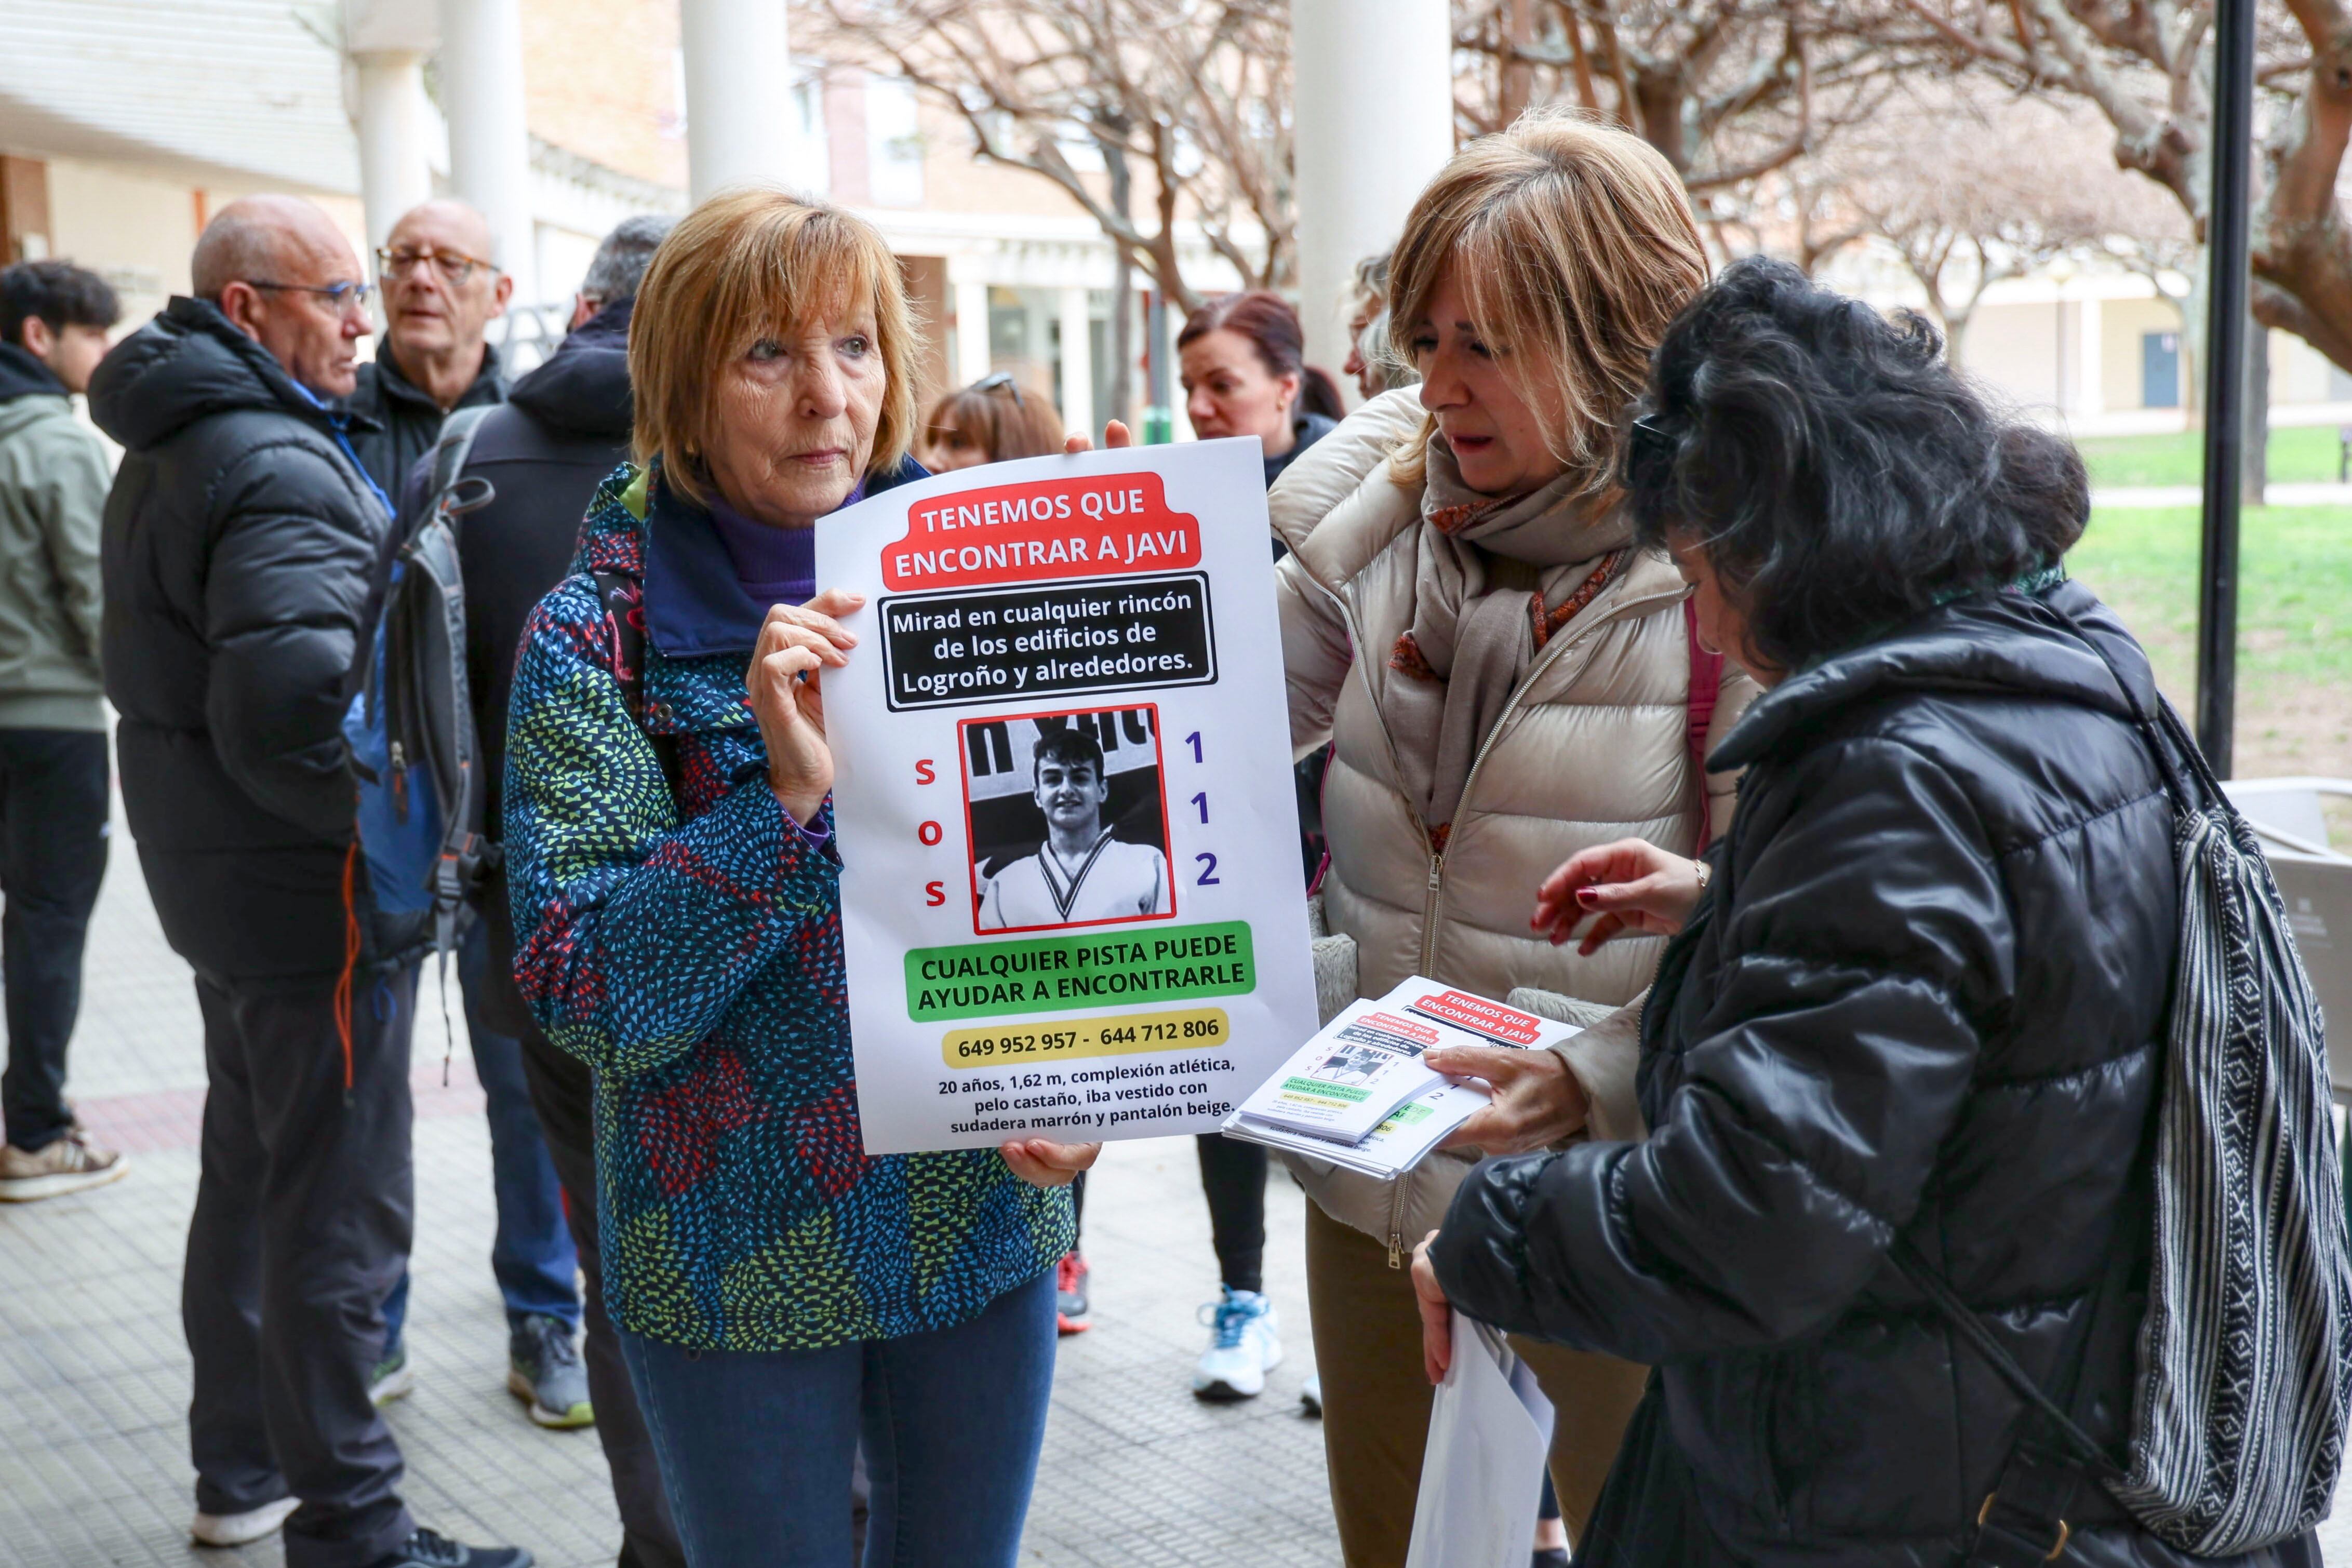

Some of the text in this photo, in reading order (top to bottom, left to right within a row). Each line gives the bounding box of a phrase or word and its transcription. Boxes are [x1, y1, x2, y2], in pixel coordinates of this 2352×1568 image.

[920, 489, 1144, 532] TENEMOS QUE
[896, 530, 1186, 578] ENCONTRAR A JAVI
[893, 591, 1191, 633] Mirad en cualquier rincón
[934, 622, 1156, 660] de los edificios de
[903, 653, 1193, 696] Logroño y alrededores.
[921, 934, 1237, 980] CUALQUIER PISTA PUEDE
[918, 962, 1245, 1010] AYUDAR A ENCONTRARLE
[1376, 1014, 1433, 1034] TENEMOS QUE
[1421, 999, 1495, 1029] ENCONTRAR
[1502, 1028, 1533, 1041] JAVI
[1445, 995, 1502, 1018] TENEMOS
[1502, 1014, 1531, 1027] QUE
[958, 1039, 994, 1057] 649
[1000, 1035, 1036, 1054] 952
[1041, 1031, 1076, 1050] 957
[1100, 1026, 1137, 1045] 644
[1141, 1023, 1178, 1041] 712
[1183, 1019, 1219, 1038] 806
[1360, 1017, 1409, 1034] ENCONTRAR
[1414, 1034, 1434, 1043] JAVI
[939, 1058, 1235, 1094] 20 años, 1,62 m, complexión atlética,
[1284, 1083, 1311, 1092] AYUDAR
[1317, 1089, 1365, 1101] ENCONTRARLE
[1290, 1078, 1327, 1089] CUALQUIER
[951, 1100, 1235, 1133] sudadera marrón y pantalón beige.
[974, 1083, 1207, 1116] pelo castaño, iba vestido con
[1404, 1105, 1426, 1114] EDE
[1269, 1126, 1297, 1136] sudadera
